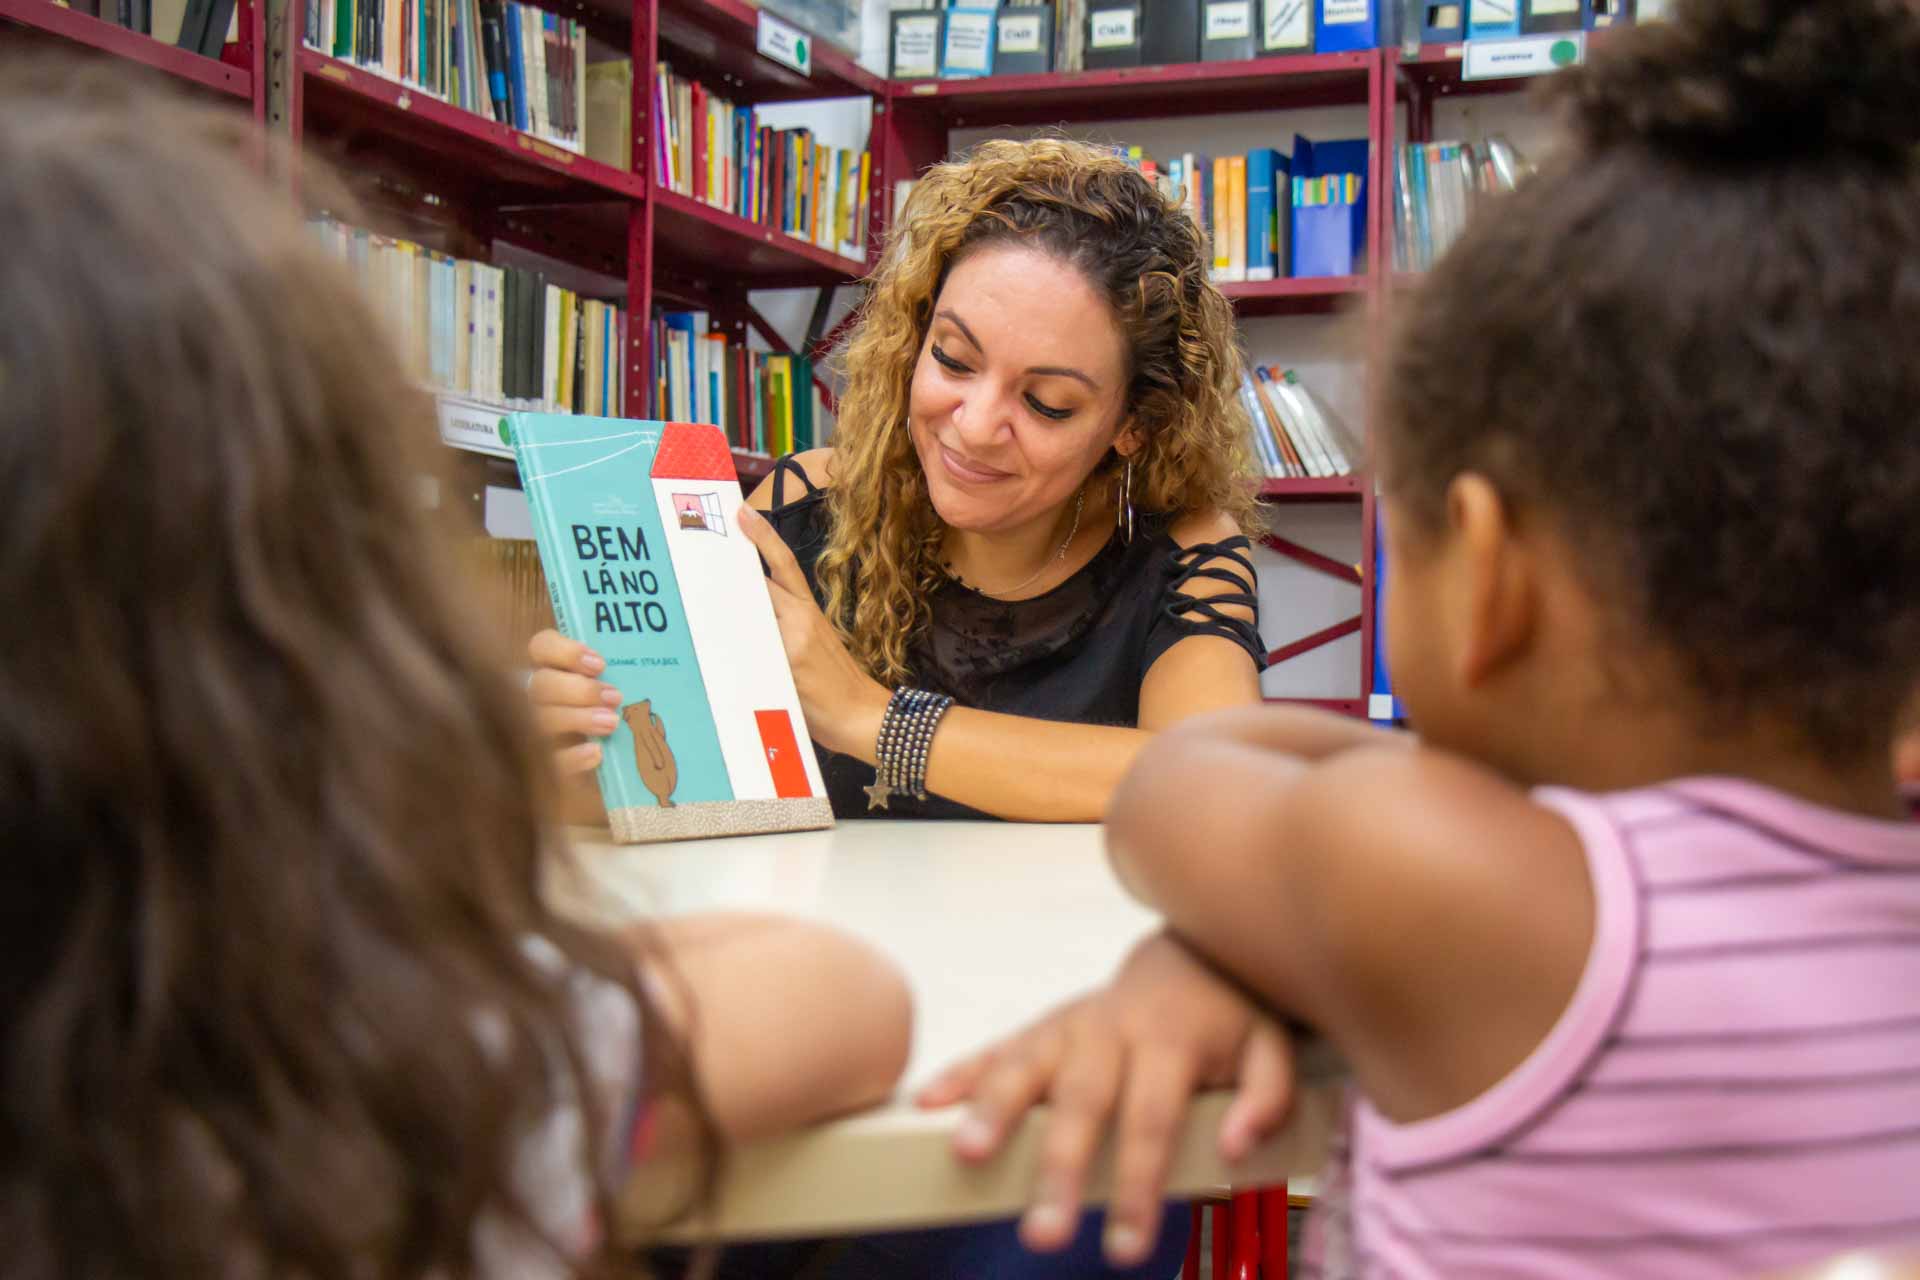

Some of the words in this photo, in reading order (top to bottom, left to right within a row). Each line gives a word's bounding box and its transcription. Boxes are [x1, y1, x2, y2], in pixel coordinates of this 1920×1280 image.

[571, 525, 651, 561] BEM
[583, 562, 618, 595] LÁ
[620, 569, 659, 595] NO
[595, 601, 668, 632] ALTO
